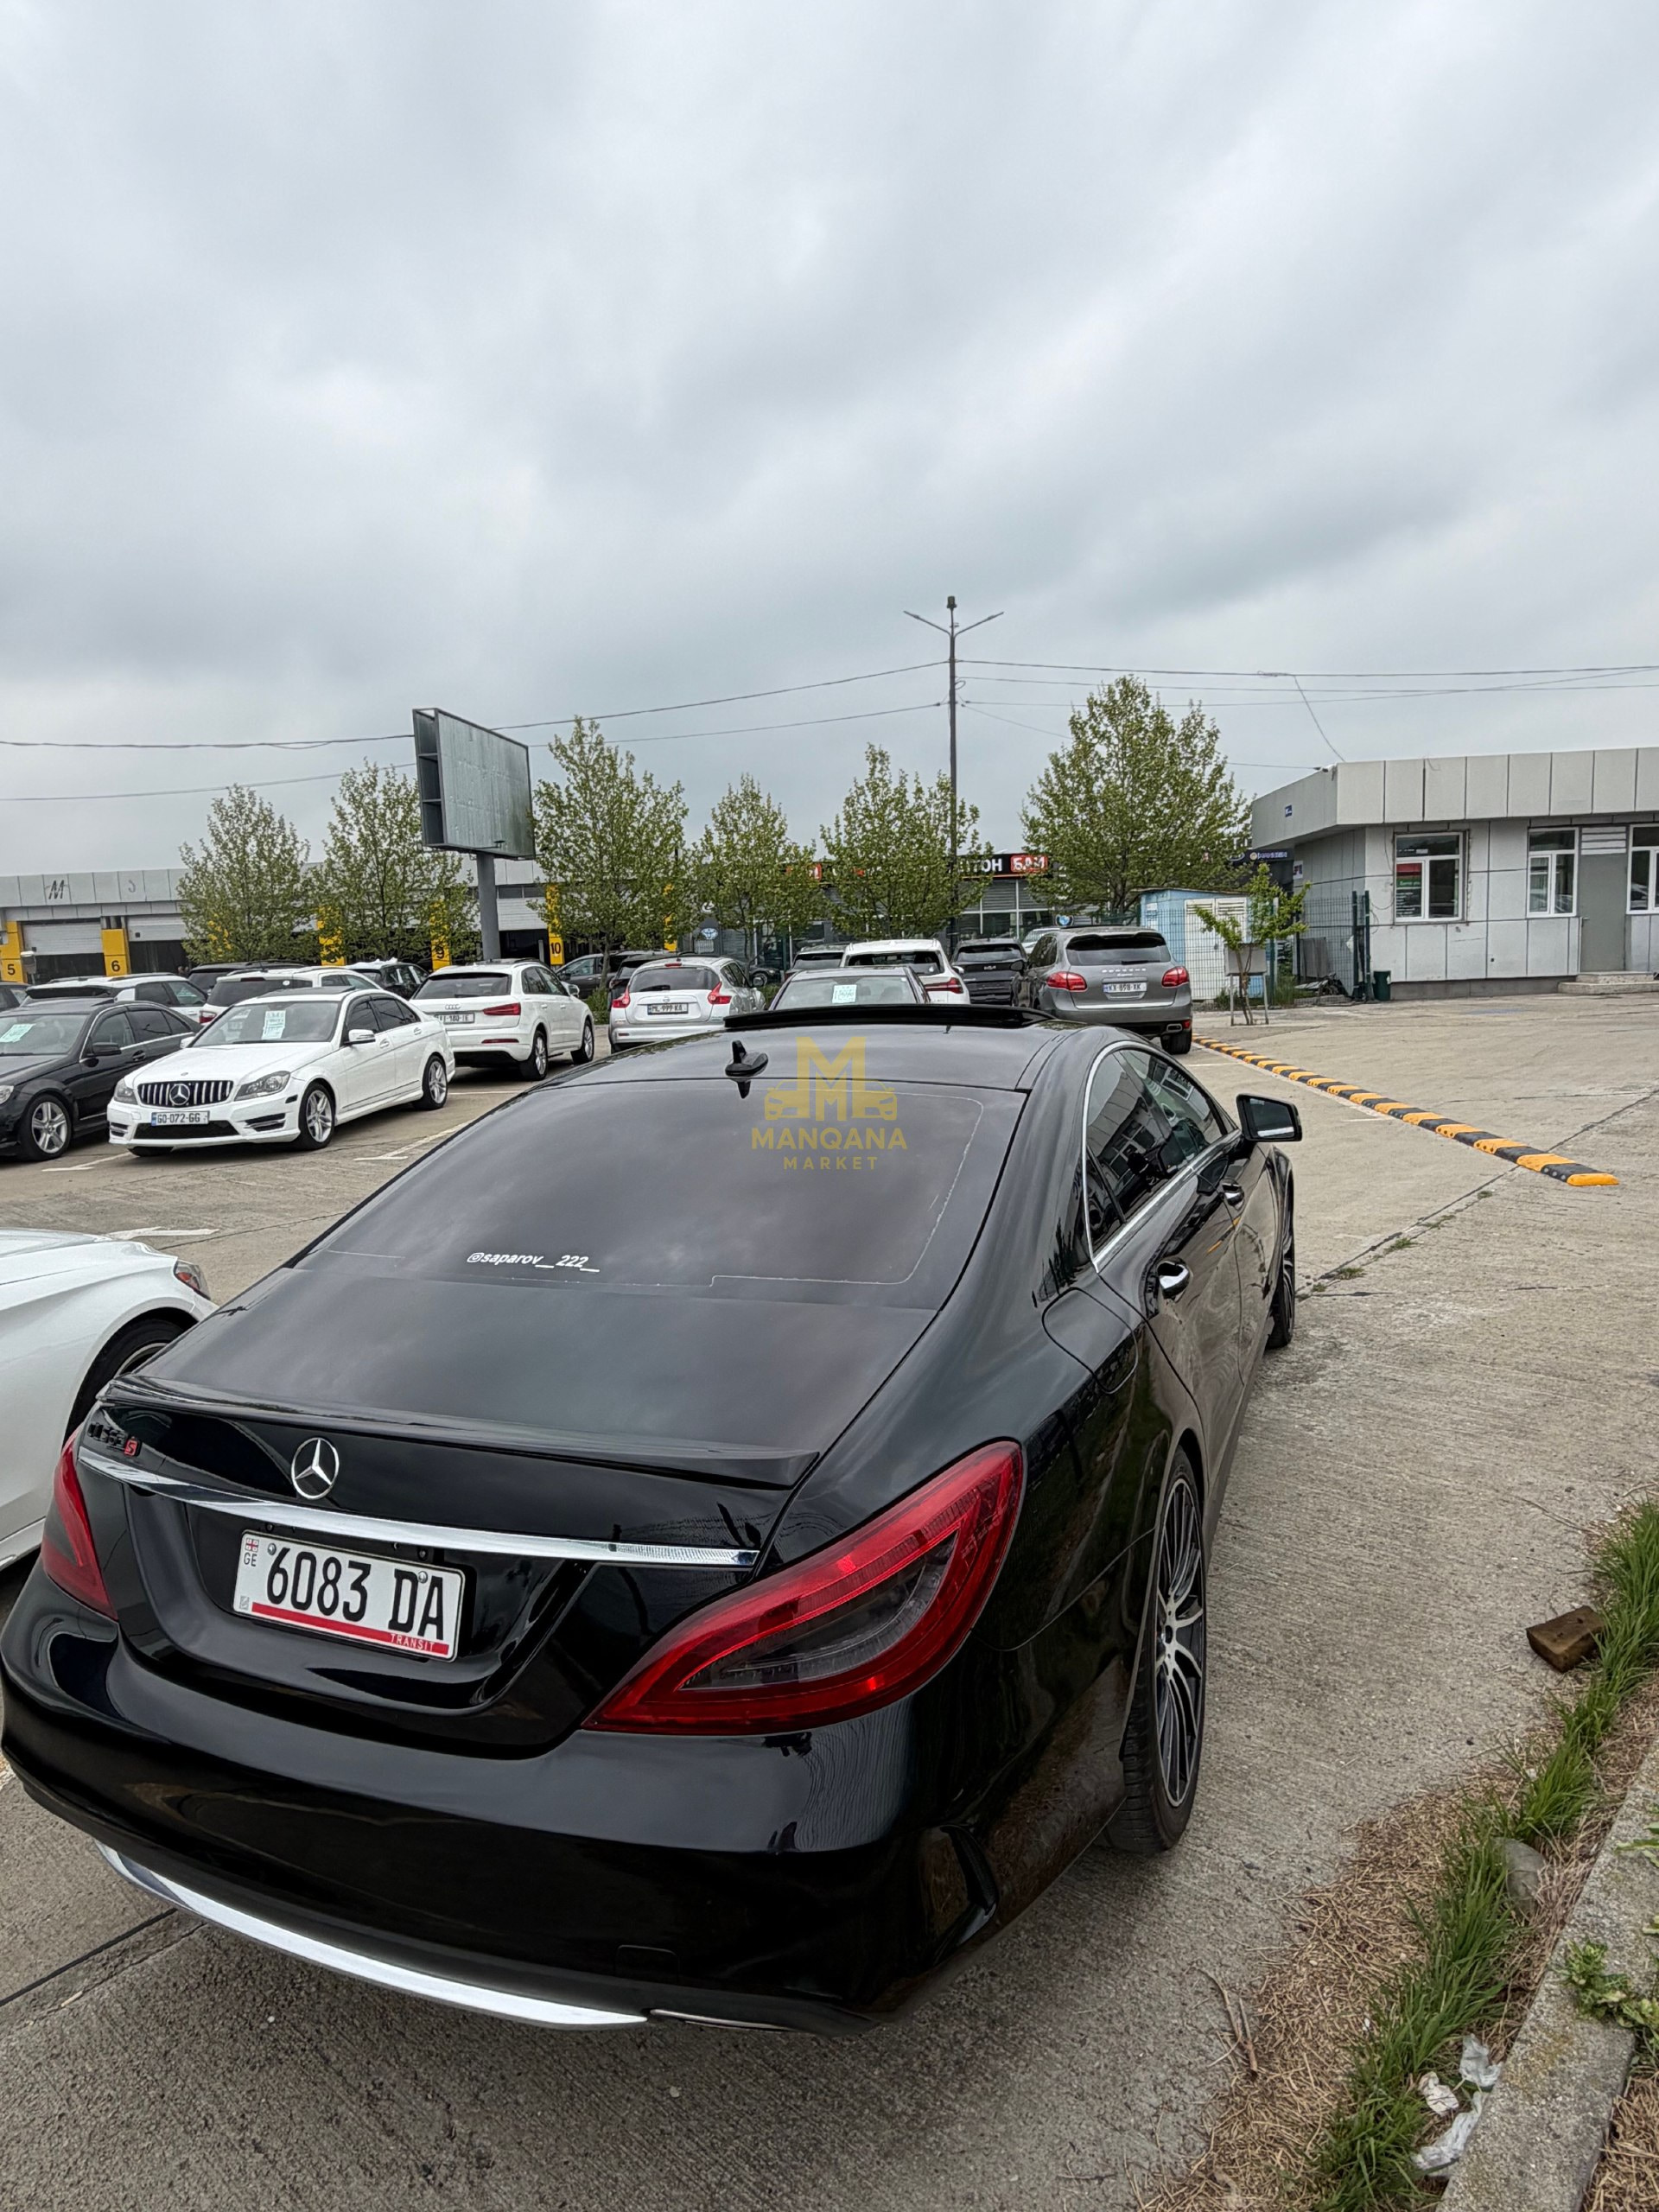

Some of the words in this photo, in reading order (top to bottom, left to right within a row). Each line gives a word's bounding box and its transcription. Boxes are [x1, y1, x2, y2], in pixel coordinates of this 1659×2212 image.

[550, 942, 561, 955] 10
[7, 963, 16, 976] 5
[111, 960, 121, 972] 6
[243, 1552, 257, 1567] GE
[266, 1547, 372, 1622] 6083
[388, 1568, 444, 1641] DA
[390, 1632, 435, 1652] TRANSIT
